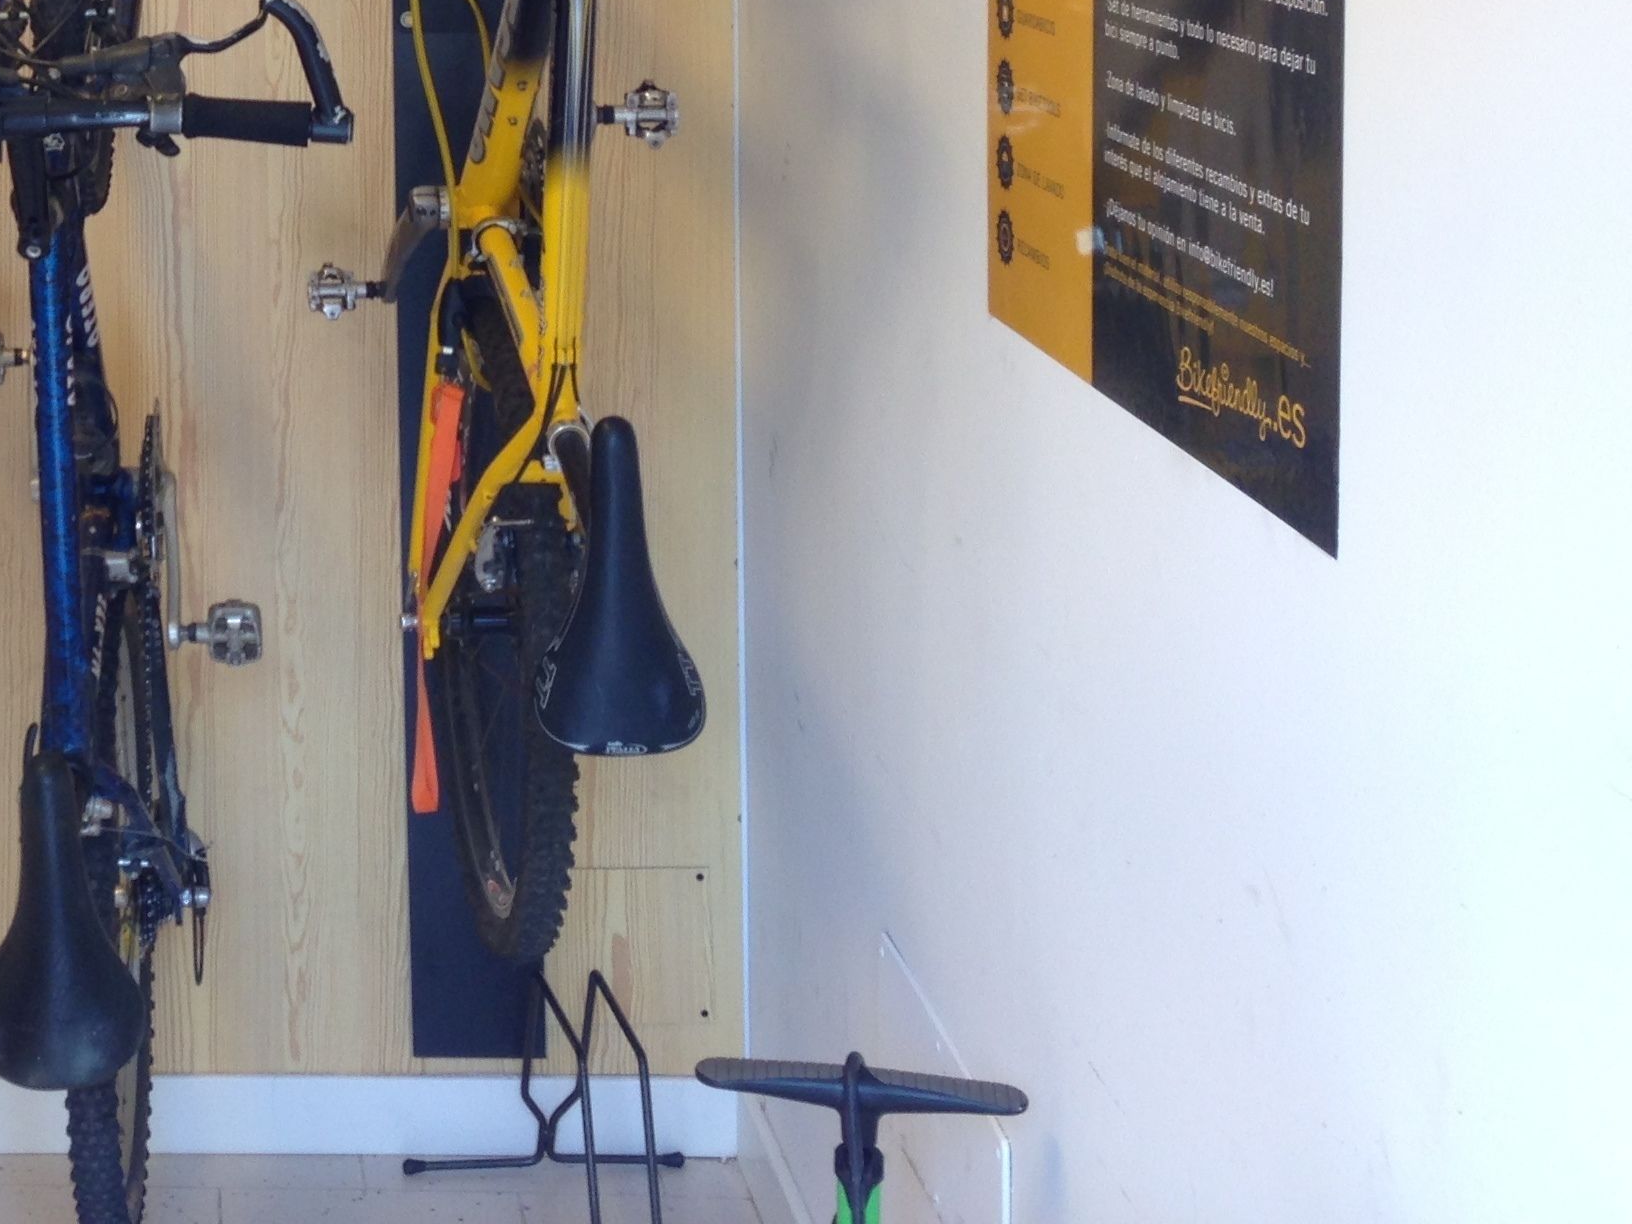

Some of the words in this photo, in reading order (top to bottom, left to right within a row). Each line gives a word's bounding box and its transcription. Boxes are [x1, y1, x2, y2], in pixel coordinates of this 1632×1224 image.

[1120, 0, 1130, 16] de
[1180, 19, 1185, 37] y
[1187, 18, 1204, 40] todo
[1206, 23, 1214, 43] lo
[1216, 31, 1256, 56] necesario
[1258, 43, 1277, 63] para
[1280, 46, 1304, 72] dejar
[1306, 53, 1316, 75] tu
[1149, 37, 1154, 51] a
[1125, 78, 1134, 96] de
[1161, 95, 1166, 112] y
[1201, 107, 1212, 126] de
[1141, 137, 1151, 155] de
[1153, 141, 1164, 161] los
[1249, 185, 1255, 205] y
[1257, 189, 1283, 214] extras
[1285, 197, 1298, 219] de
[1299, 204, 1310, 226] tu
[1198, 187, 1219, 214] tiene
[1221, 202, 1226, 217] a
[1228, 200, 1237, 222] la
[1239, 210, 1265, 235] venta.
[1176, 236, 1186, 252] en
